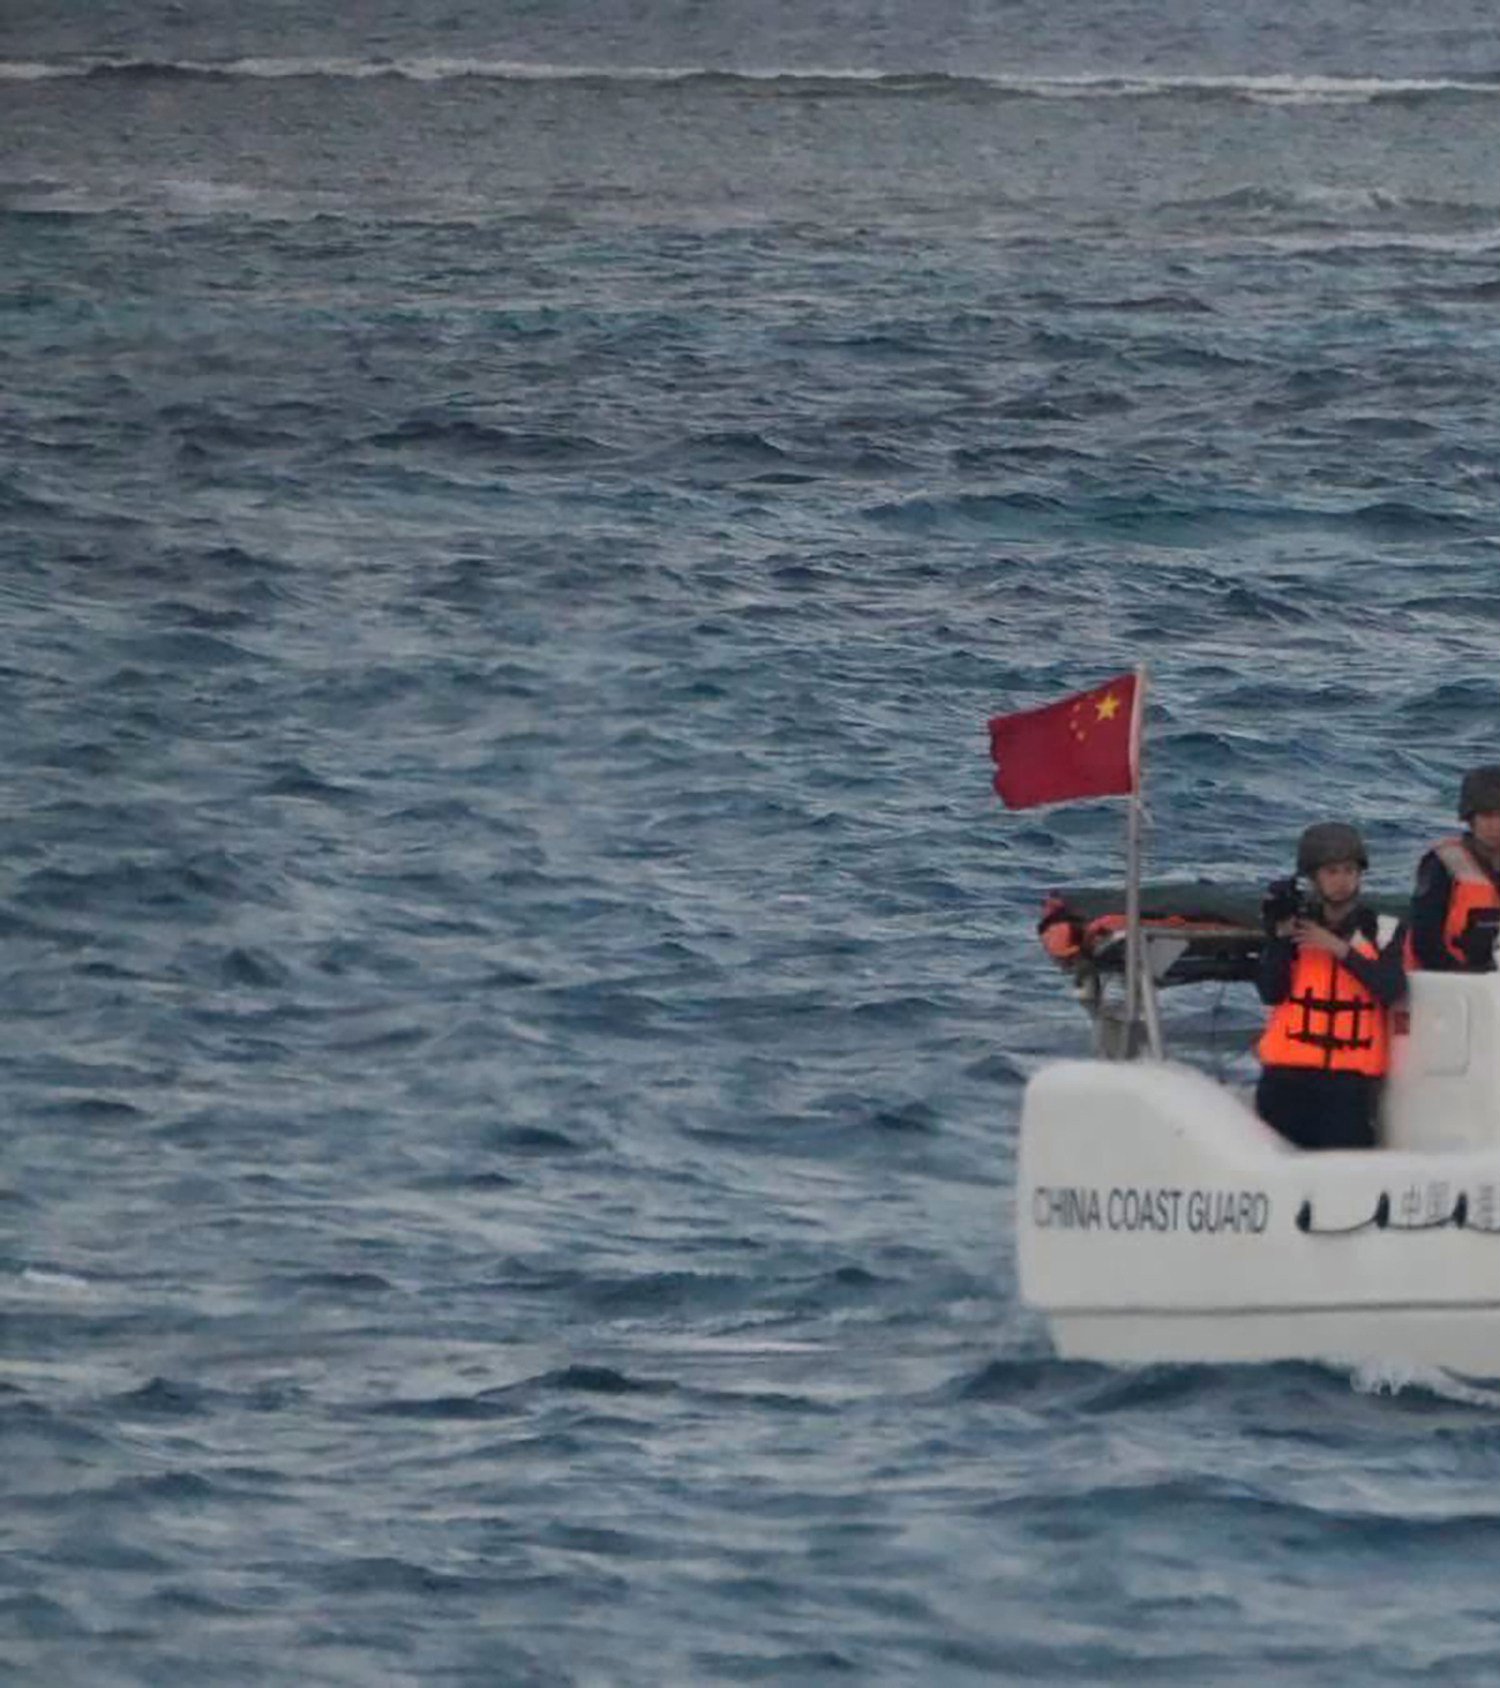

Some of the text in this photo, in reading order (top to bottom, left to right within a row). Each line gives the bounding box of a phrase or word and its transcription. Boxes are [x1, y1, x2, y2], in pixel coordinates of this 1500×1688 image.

[1034, 1186, 1269, 1234] CHINA COAST GUARD
